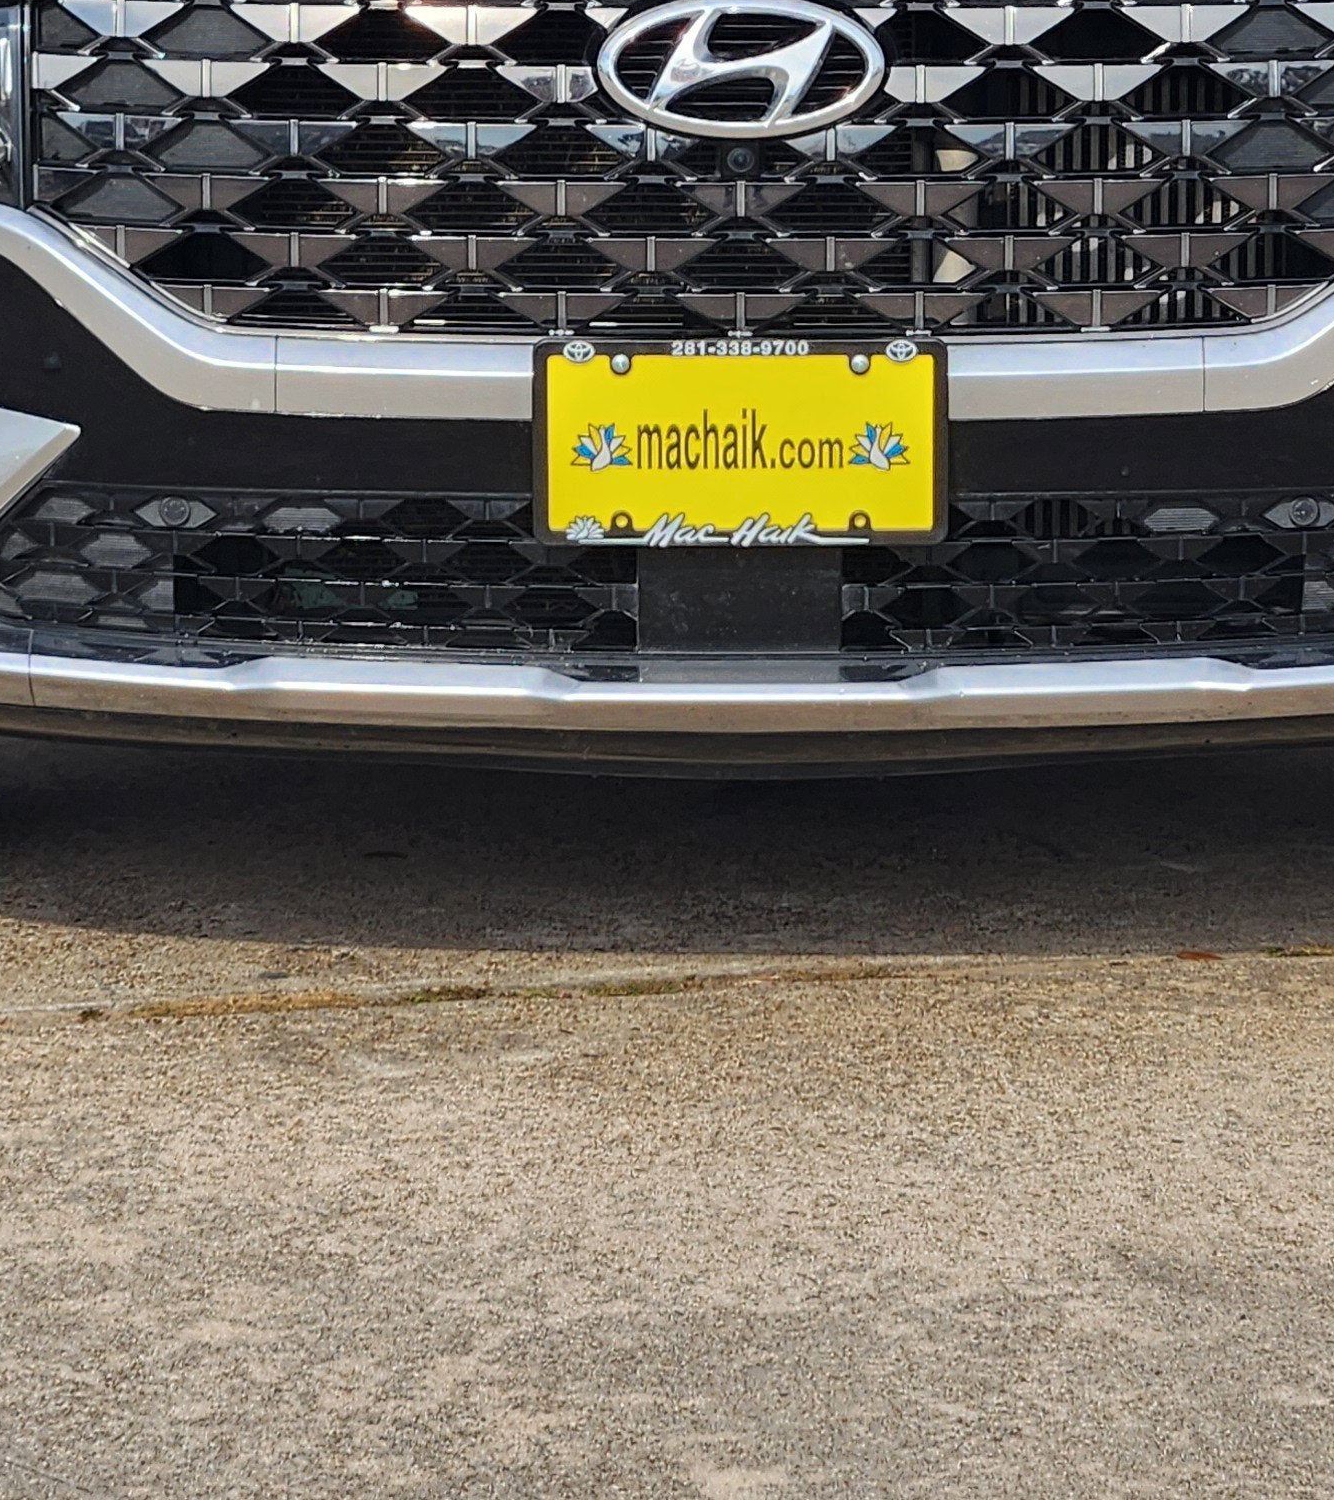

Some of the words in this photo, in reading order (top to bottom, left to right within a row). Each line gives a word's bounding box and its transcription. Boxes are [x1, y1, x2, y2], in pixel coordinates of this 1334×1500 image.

[670, 339, 810, 356] 281-338-9700
[636, 408, 845, 471] machaik.com
[642, 512, 727, 548] Mac
[730, 512, 832, 547] Haik
